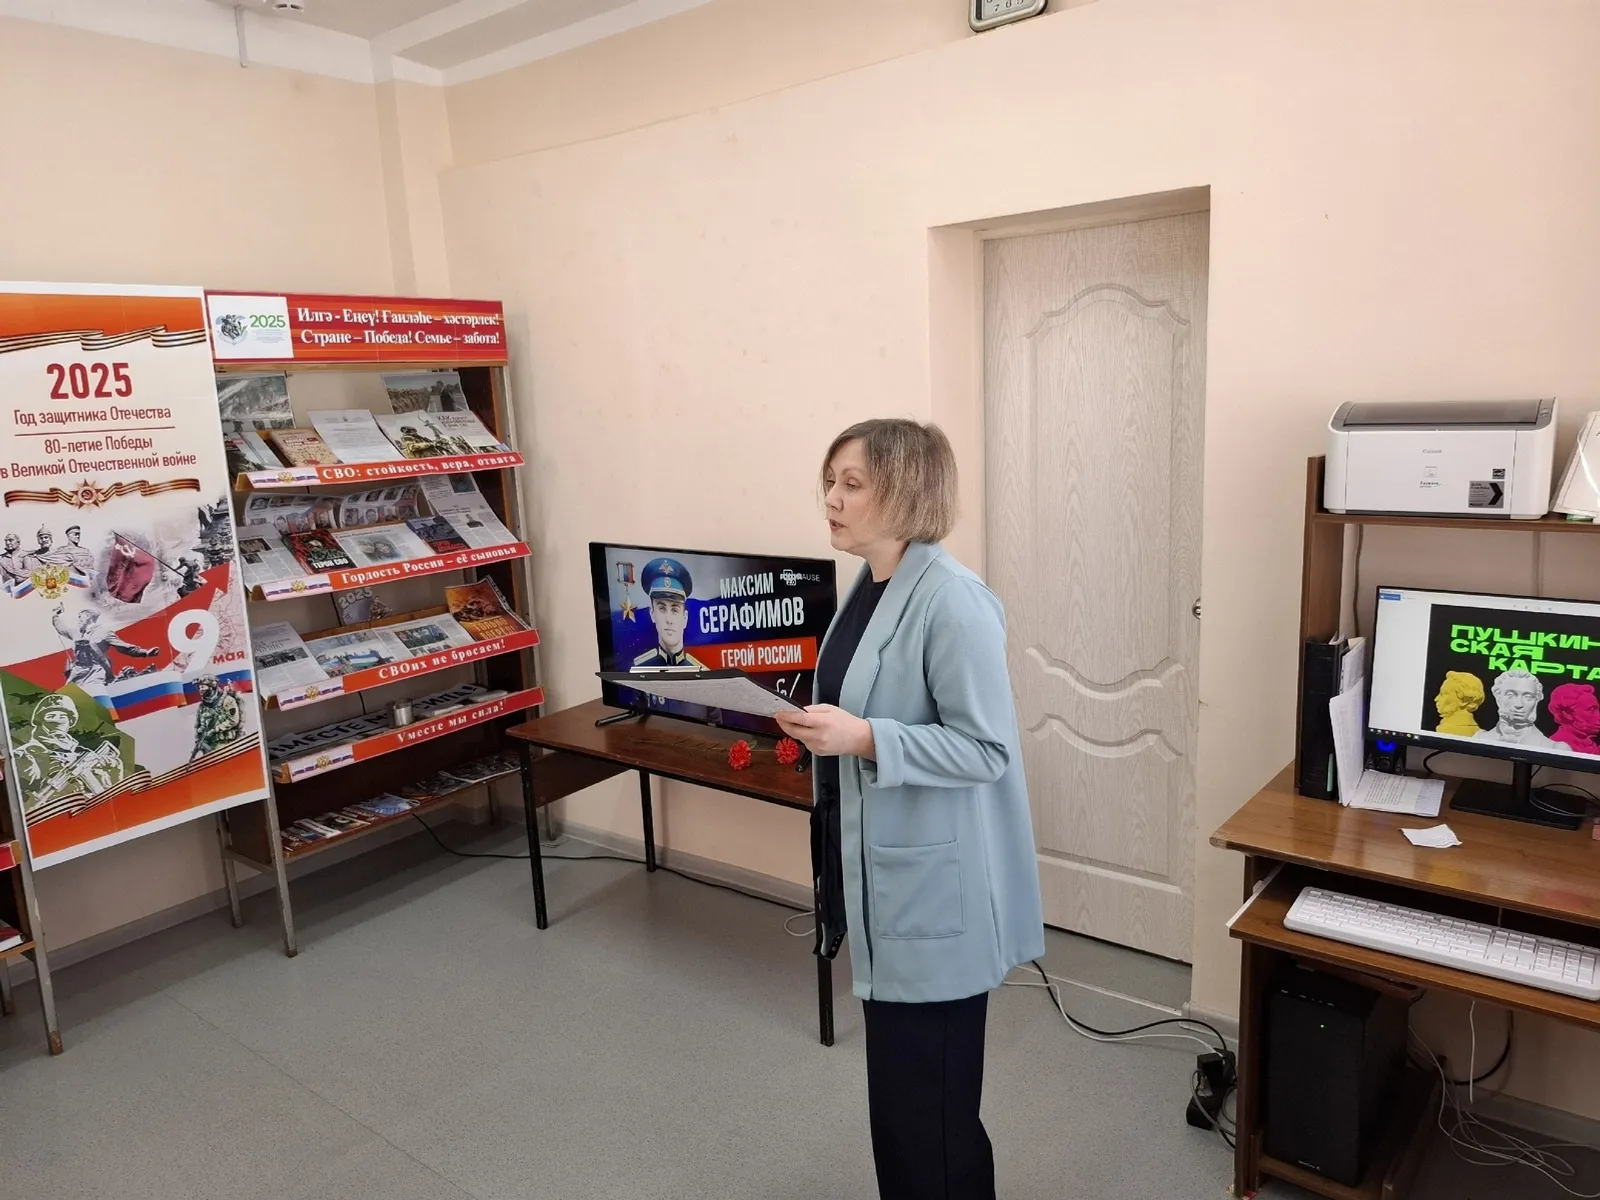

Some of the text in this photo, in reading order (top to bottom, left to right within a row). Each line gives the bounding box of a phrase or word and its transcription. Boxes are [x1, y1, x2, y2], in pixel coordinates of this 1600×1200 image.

[249, 314, 286, 328] 2025
[296, 307, 333, 322] Илгә
[342, 308, 380, 327] Еңеү!
[443, 313, 500, 329] хәстәрлек!
[300, 329, 352, 347] Стране
[364, 330, 412, 345] Победа!
[414, 330, 453, 345] Семье
[462, 332, 500, 345] забота!
[46, 362, 133, 400] 2025
[13, 406, 172, 427] Год защитника Отечества
[44, 436, 153, 455] 80-летие Победы
[0, 451, 197, 479] в Великой Отечественной войне
[322, 456, 517, 480] СВО: стойкость, вера, отвага
[341, 567, 401, 585] Гордость
[402, 559, 445, 573] России
[456, 553, 469, 564] её
[470, 547, 517, 561] сыновья
[719, 572, 774, 599] МАКСИМ
[338, 587, 374, 610] 2025
[472, 617, 508, 632] ТОЛЬКО
[699, 596, 805, 634] СЕРАФИМОВ
[168, 609, 220, 674] 9
[1450, 638, 1544, 661] СКАЯ
[212, 650, 245, 664] мая
[378, 638, 506, 679] СВОих не бросаем!
[721, 644, 802, 668] ГЕРОЙ РОССИИ
[448, 715, 467, 728] мы
[471, 701, 505, 720] сила!
